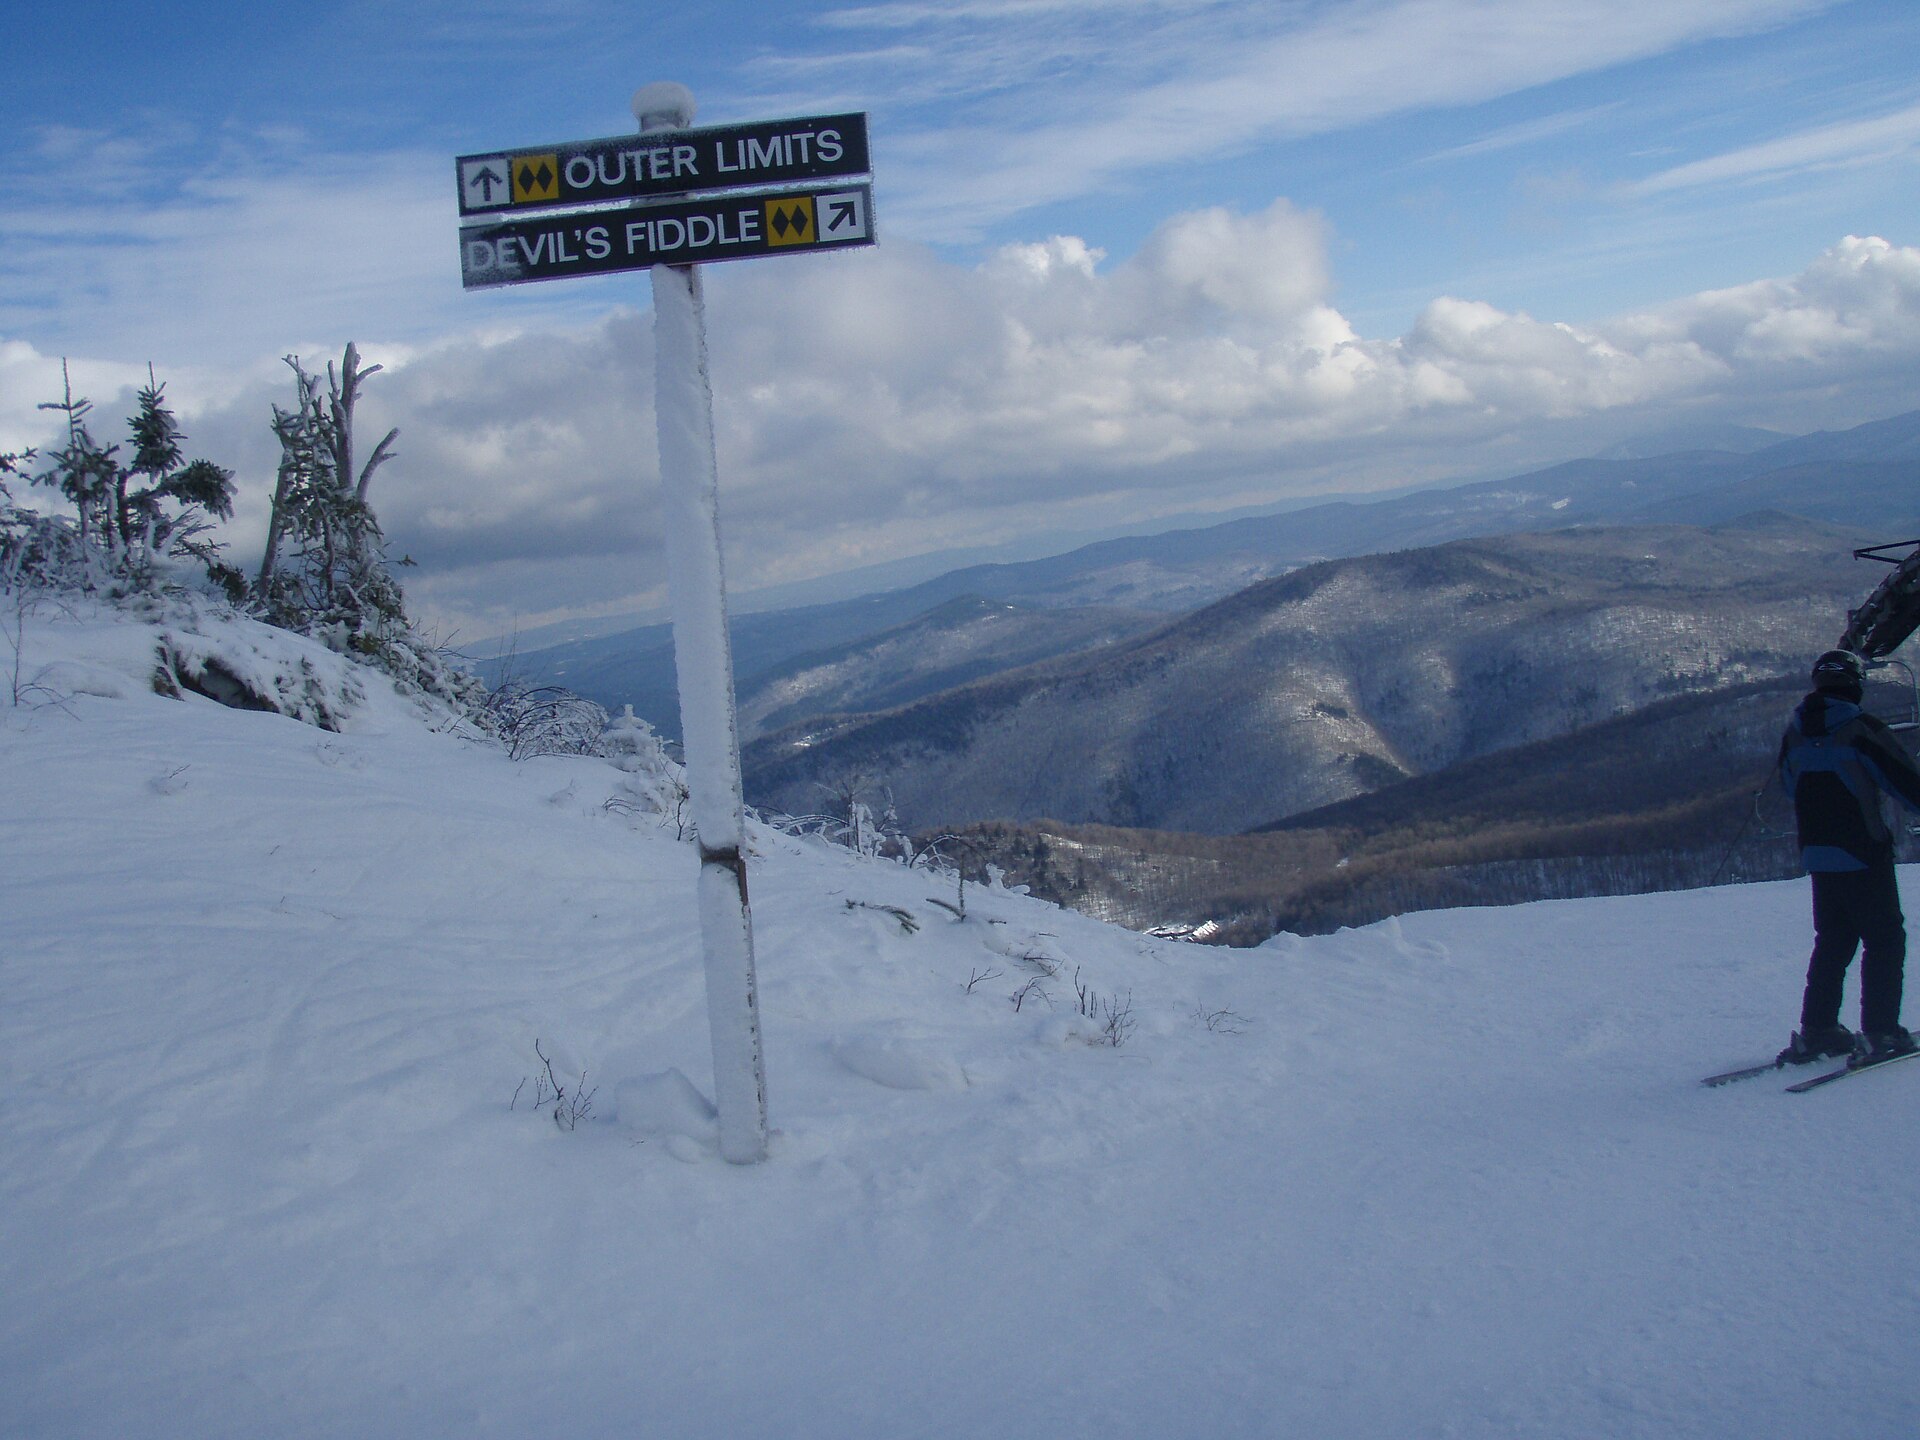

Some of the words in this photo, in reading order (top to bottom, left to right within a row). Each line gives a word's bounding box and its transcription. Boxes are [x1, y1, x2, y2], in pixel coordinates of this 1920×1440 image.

[565, 145, 699, 189] OUTER
[716, 129, 843, 173] LIMITS
[468, 226, 611, 272] DEVIL'S
[626, 209, 761, 254] FIDDLE
